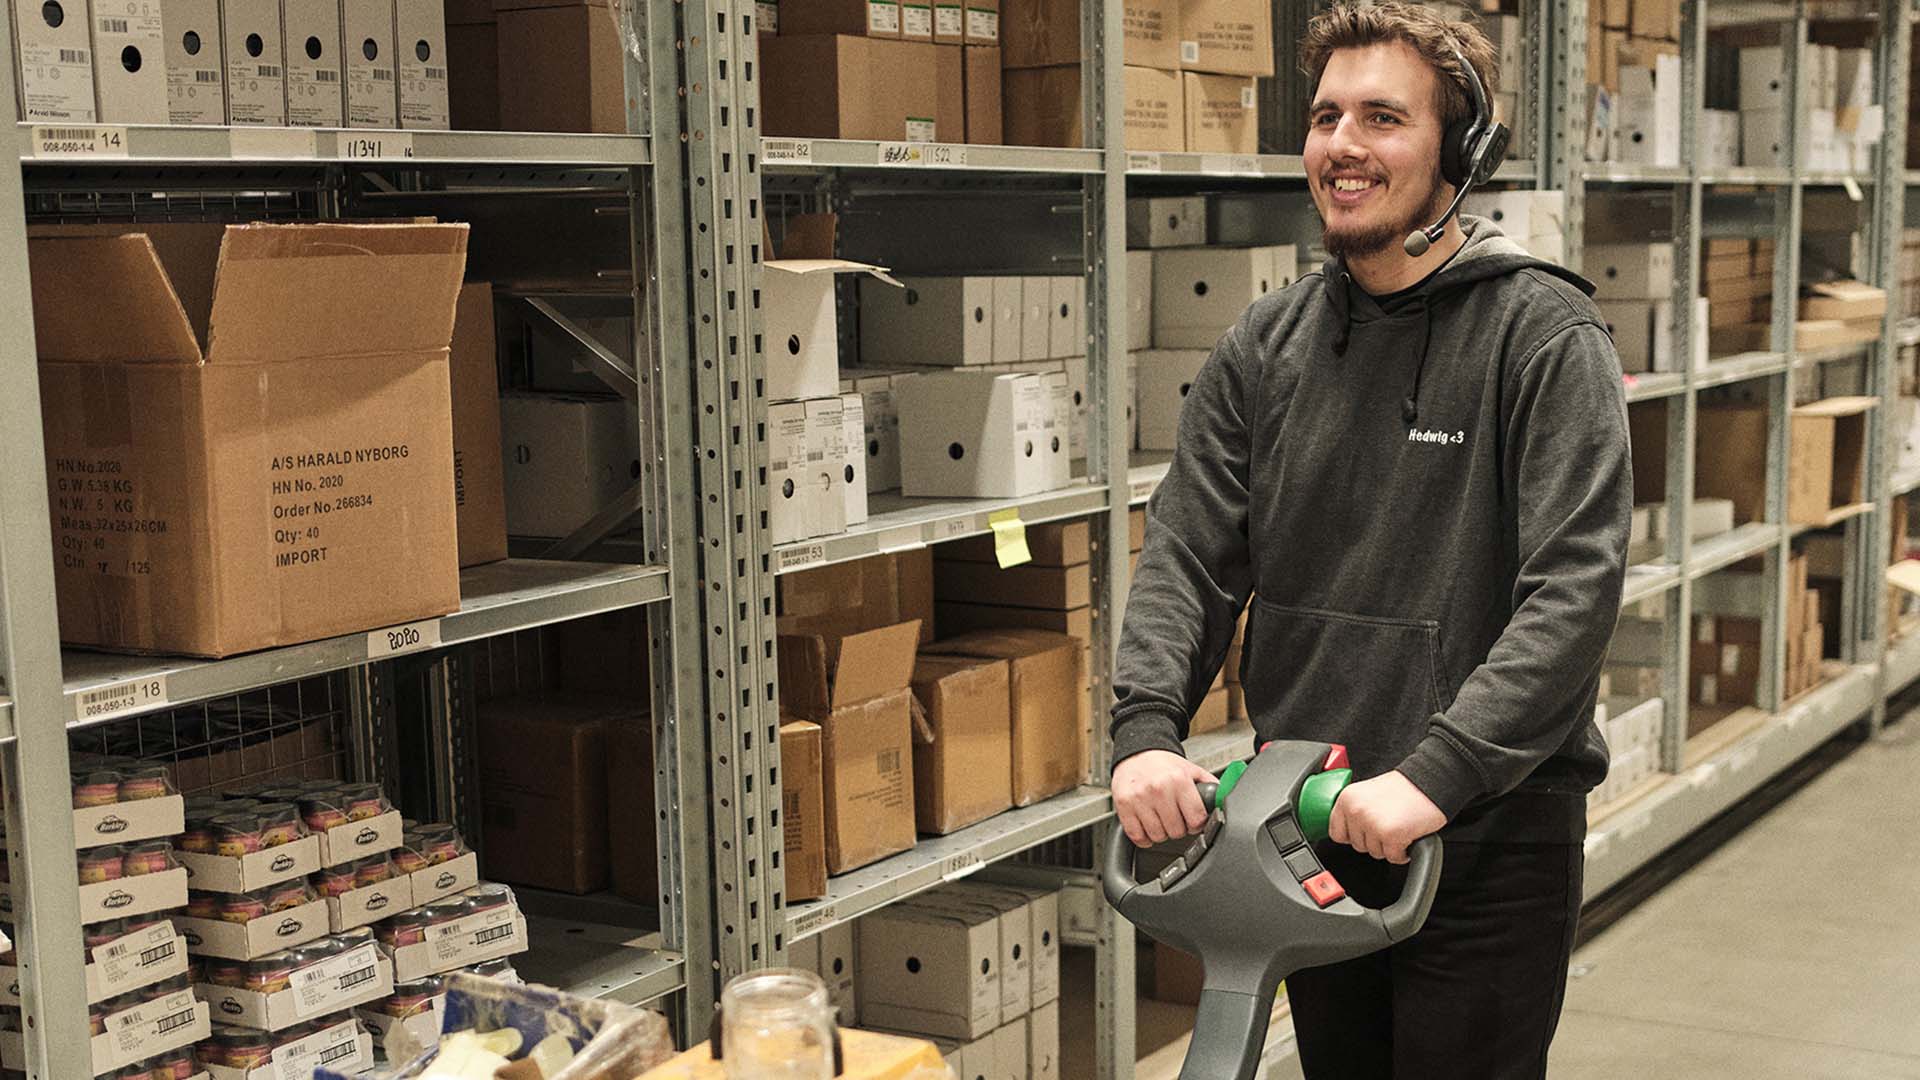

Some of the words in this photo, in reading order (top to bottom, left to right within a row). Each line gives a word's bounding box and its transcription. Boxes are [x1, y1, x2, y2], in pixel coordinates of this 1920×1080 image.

[101, 132, 121, 148] 14
[347, 139, 382, 158] 11341
[796, 143, 809, 156] 82
[1408, 428, 1449, 445] Hedwig
[1450, 430, 1465, 444] <3
[56, 458, 74, 473] HN
[271, 456, 294, 471] A/S
[297, 451, 352, 468] HARALD
[355, 445, 409, 463] NYBORG
[113, 479, 133, 494] KG
[272, 481, 291, 495] HN
[295, 479, 316, 492] No.
[319, 474, 344, 489] 2020
[113, 498, 133, 513] KG
[273, 504, 310, 519] Order
[93, 536, 105, 550] 40
[274, 529, 302, 545] Qty:
[306, 526, 320, 539] 40
[275, 547, 328, 567] IMPORT
[811, 545, 823, 558] 53
[387, 627, 420, 651] 2020
[141, 681, 161, 698] 18
[86, 696, 135, 716] 008-050-1-3
